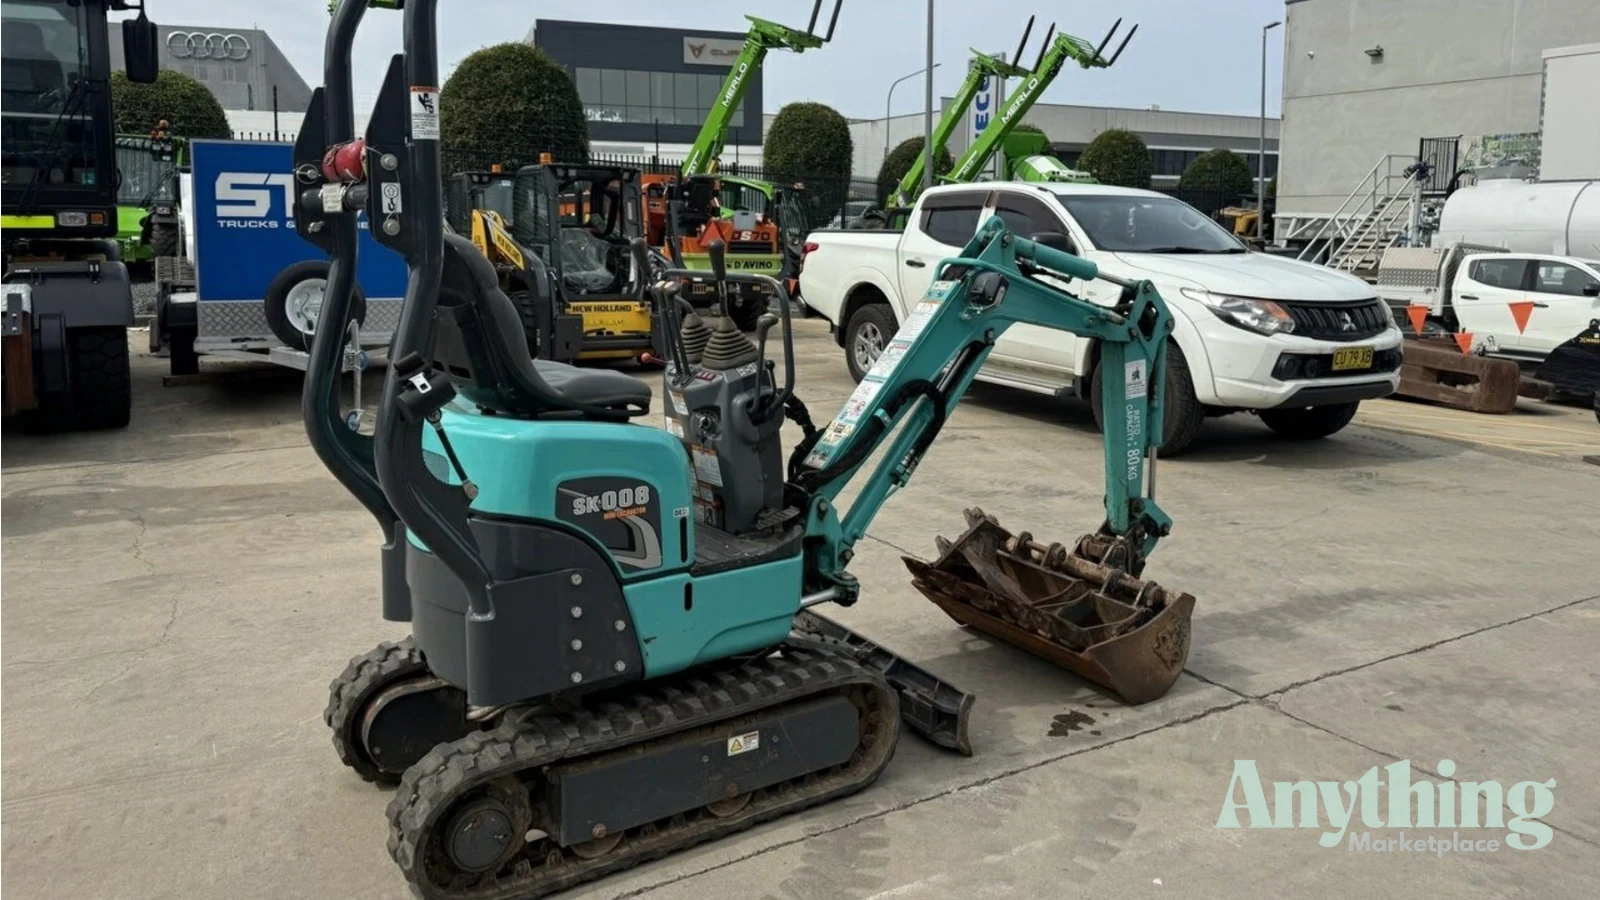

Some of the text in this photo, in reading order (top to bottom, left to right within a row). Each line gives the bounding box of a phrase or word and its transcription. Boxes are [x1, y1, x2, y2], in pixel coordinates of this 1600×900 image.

[722, 62, 747, 107] MERLO
[1001, 77, 1039, 124] MERLO
[217, 220, 278, 228] TRUCKS
[732, 231, 770, 240] DS70
[572, 304, 632, 312] NEW HOLLAND
[1126, 404, 1134, 441] CAPACITY
